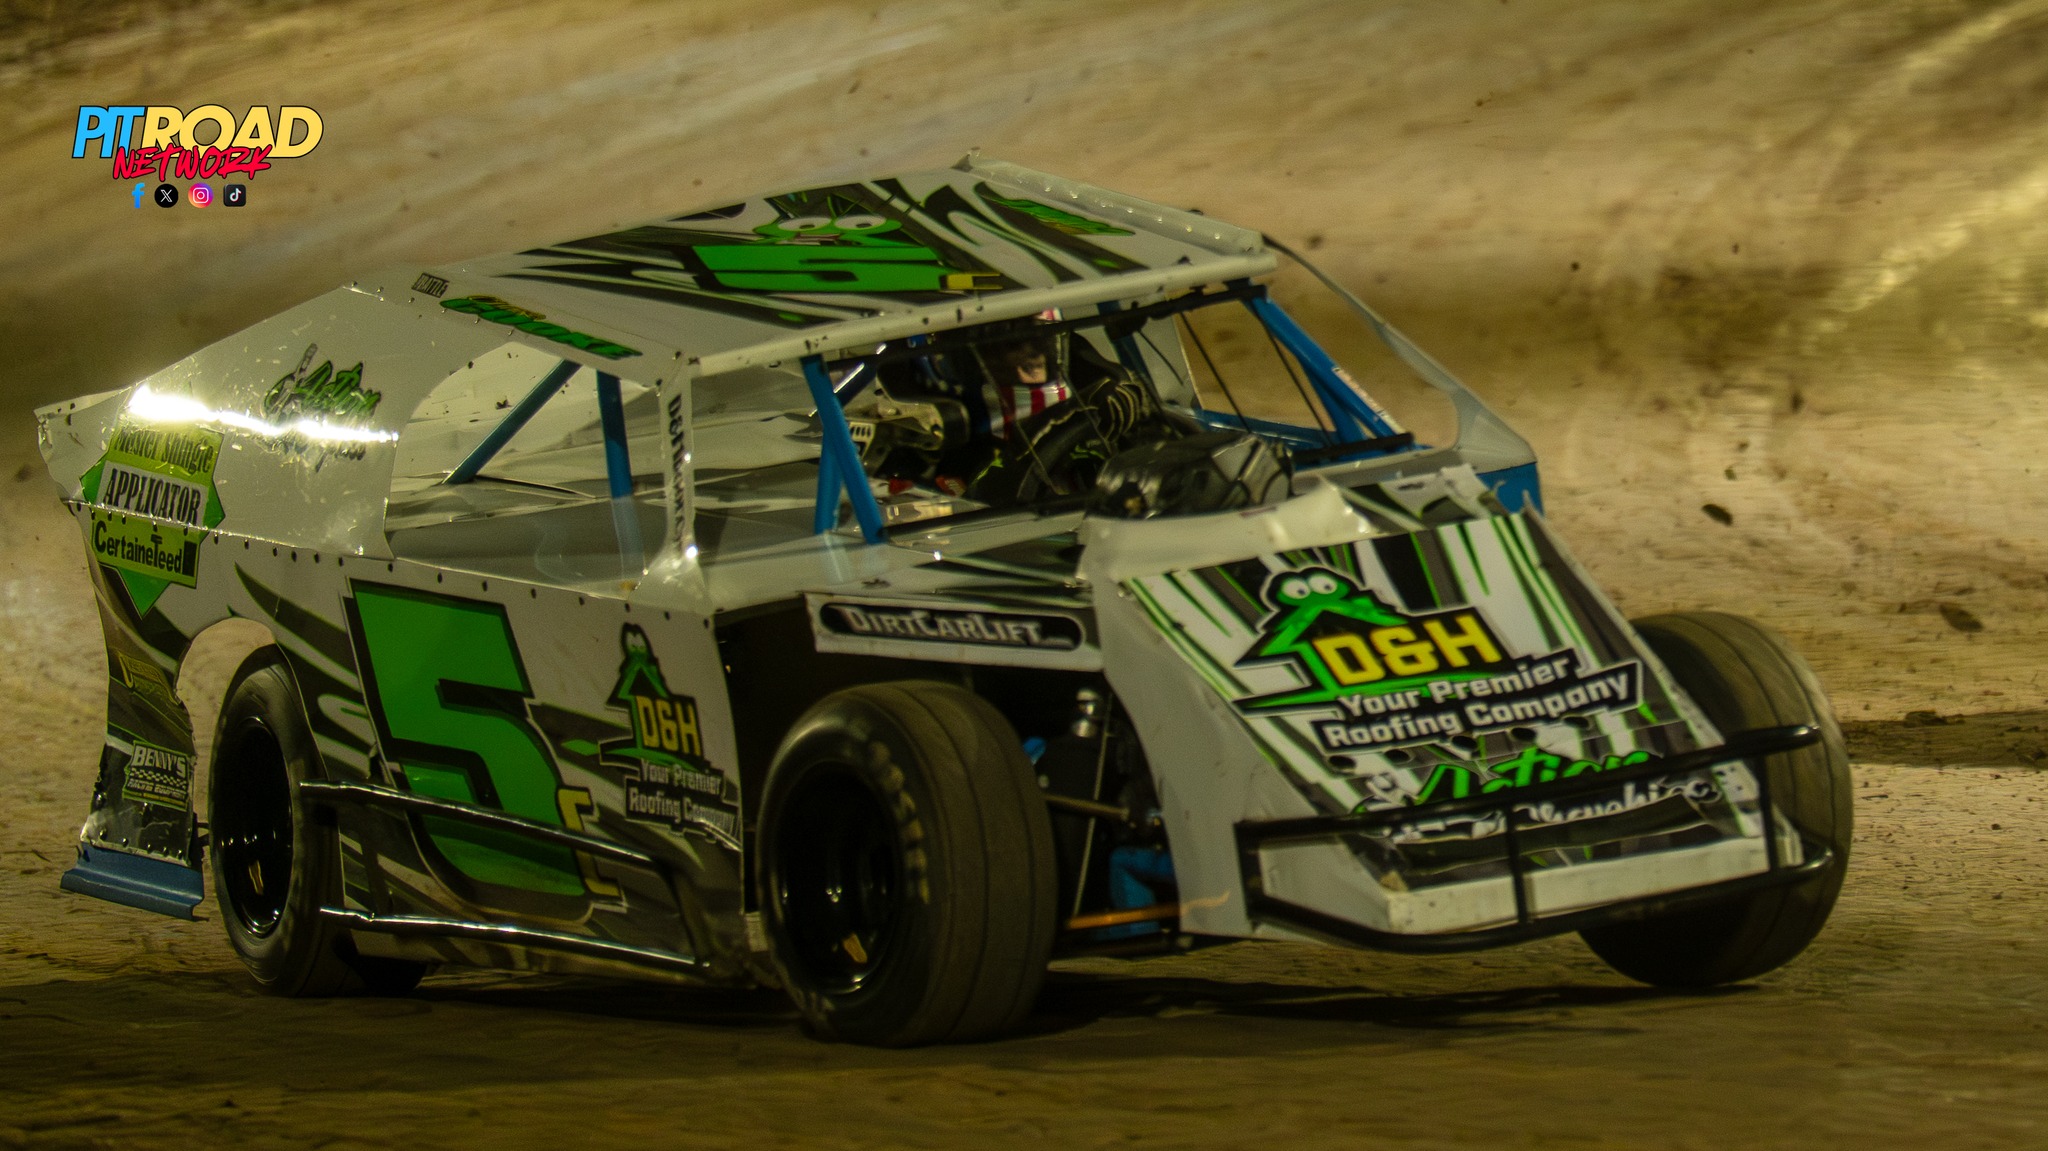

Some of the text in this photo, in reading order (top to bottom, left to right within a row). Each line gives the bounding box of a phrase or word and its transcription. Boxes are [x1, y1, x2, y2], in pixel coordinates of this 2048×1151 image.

[102, 468, 201, 526] APPLICATOR
[1313, 614, 1502, 686] D&H
[1321, 672, 1630, 748] Roofing Company
[1338, 656, 1570, 717] Your Premier
[636, 695, 701, 757] D&H
[131, 745, 187, 778] BENNY'S
[629, 787, 681, 824] Roofing
